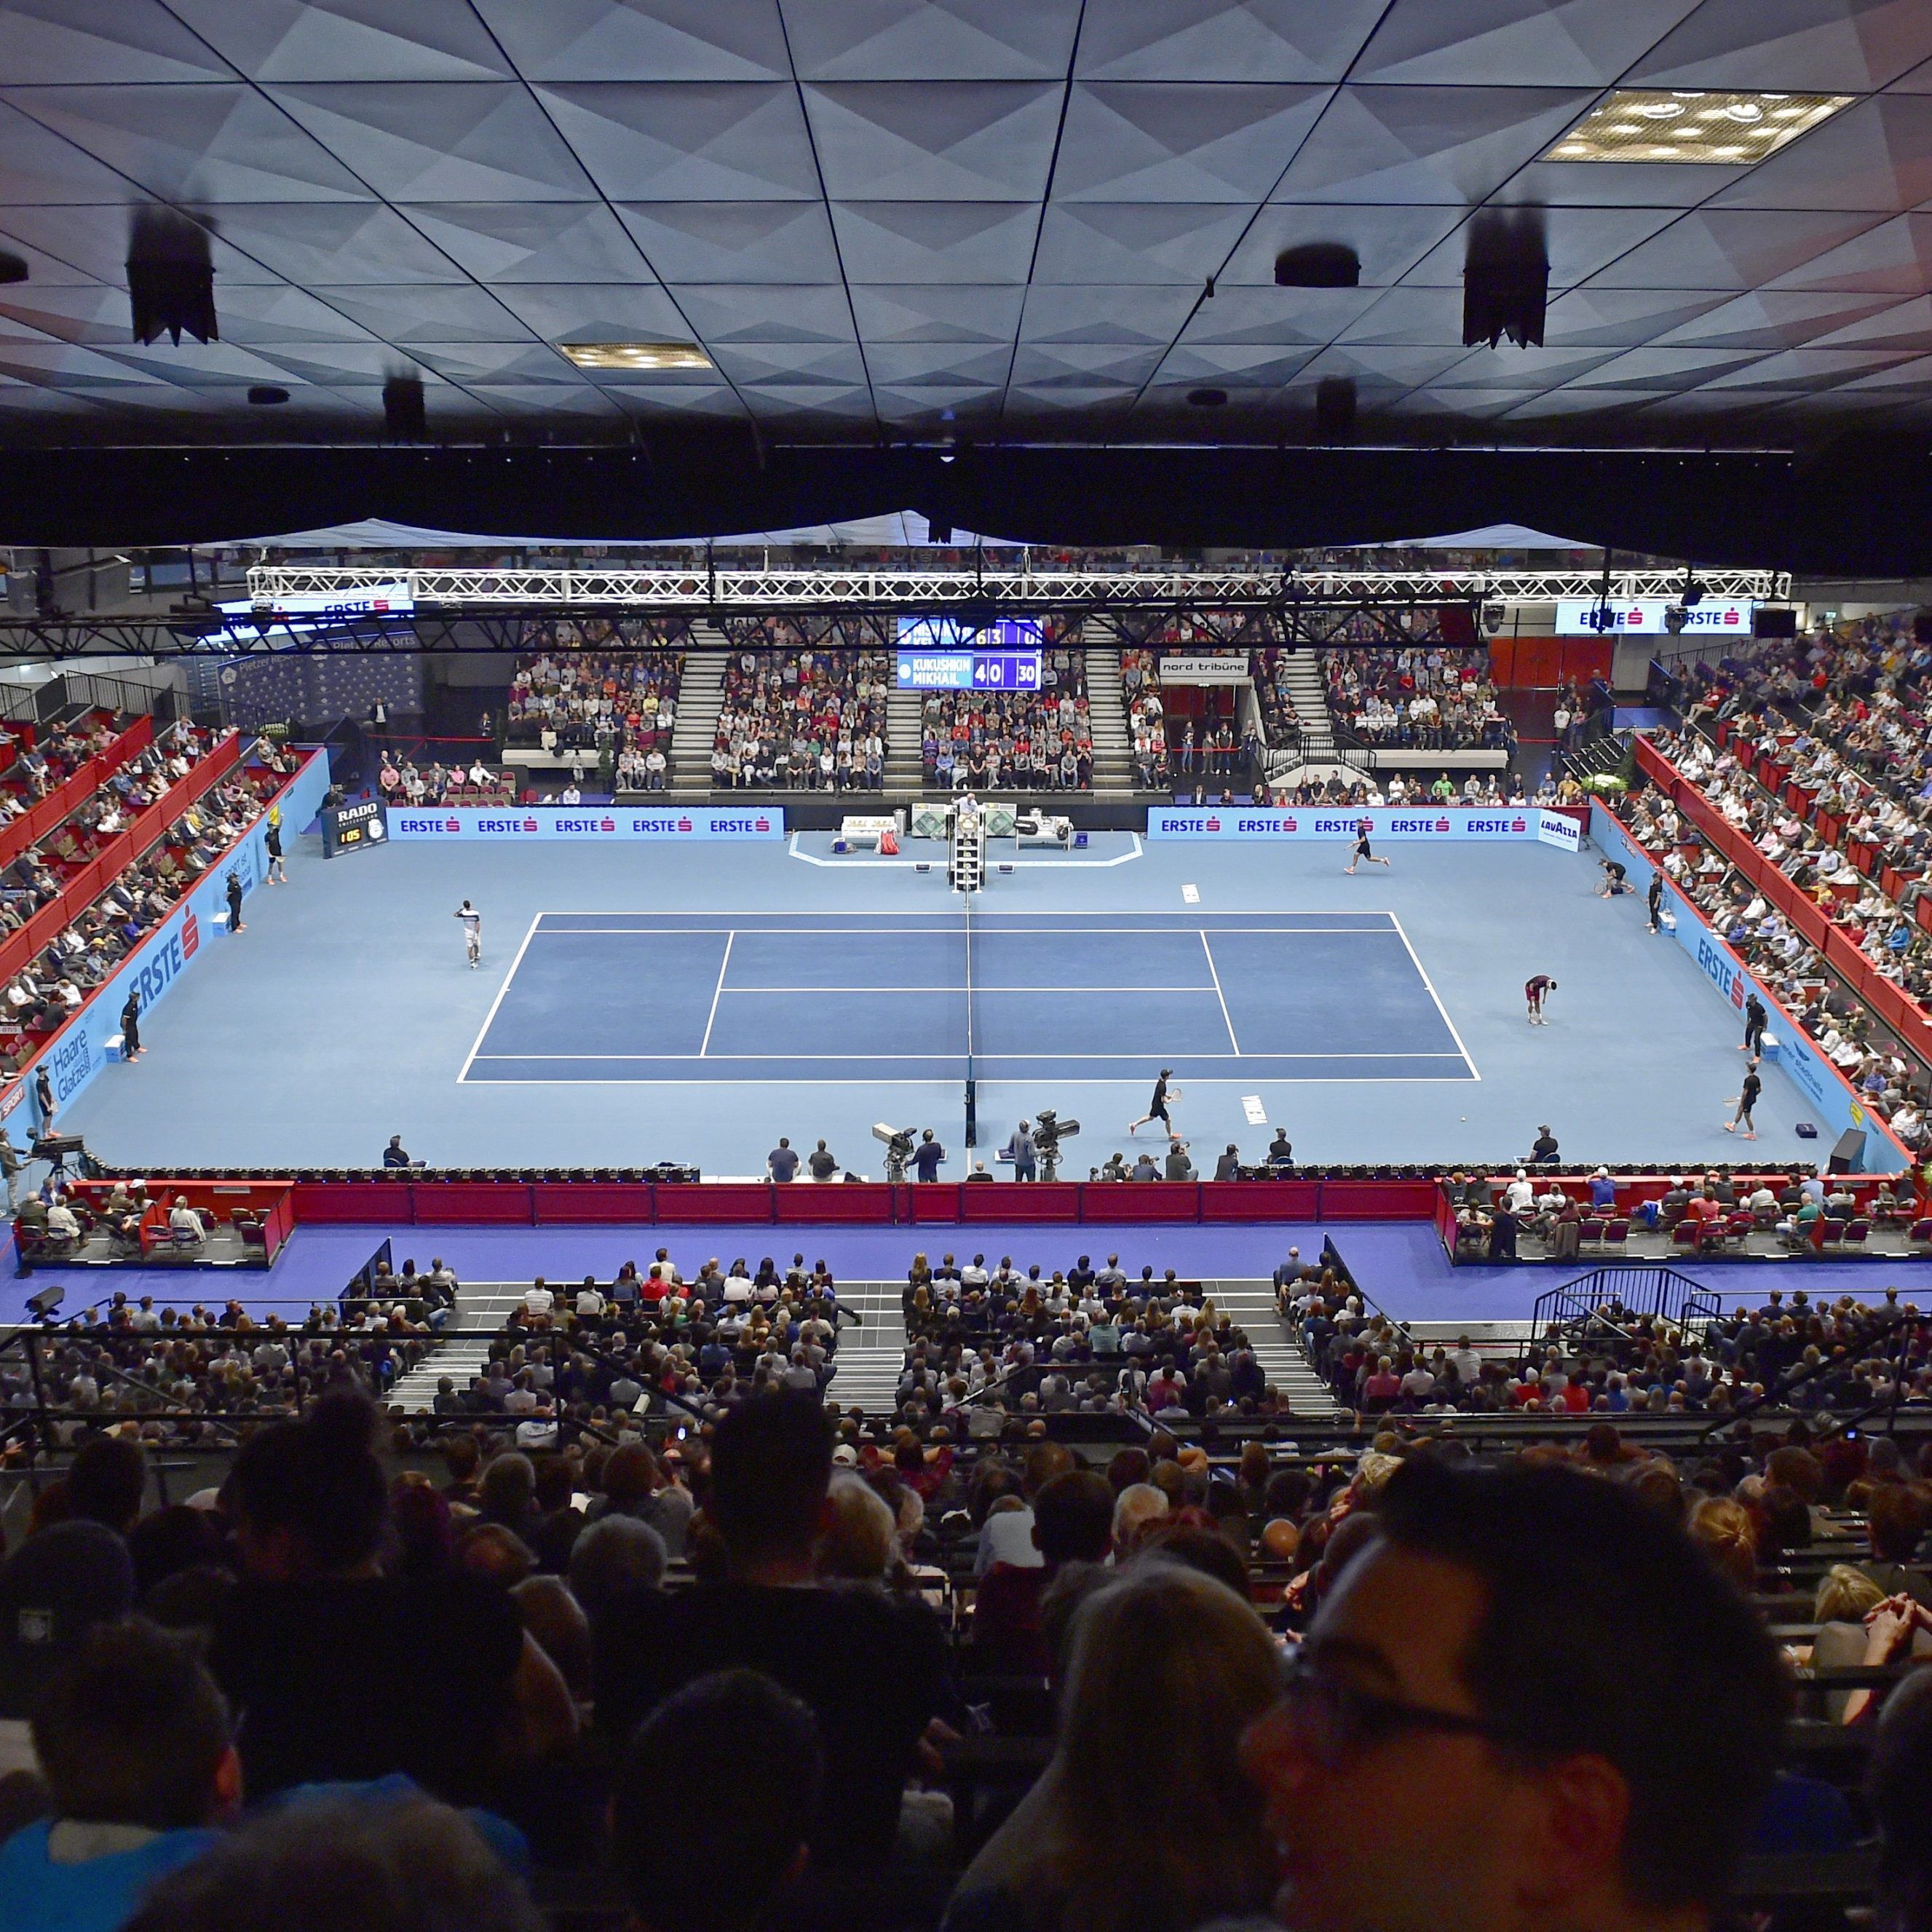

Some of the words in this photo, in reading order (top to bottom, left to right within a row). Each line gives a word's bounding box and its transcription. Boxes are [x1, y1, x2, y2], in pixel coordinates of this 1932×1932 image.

[913, 659, 970, 671] KUKUSHKIN
[1163, 662, 1193, 670] nord
[1198, 662, 1245, 670] tribüne
[913, 672, 959, 685] MIKHAIL
[975, 664, 986, 682] 4
[990, 665, 1001, 682] 0
[1019, 665, 1034, 682] 30
[337, 802, 377, 823] RADO
[401, 820, 443, 831] ERSTE
[478, 820, 520, 831] ERSTE
[555, 820, 598, 831] ERSTE
[633, 820, 676, 831] ERSTE
[710, 820, 753, 831] ERSTE
[1162, 820, 1203, 831] ERSTE
[1238, 820, 1280, 831] ERSTE
[1315, 820, 1357, 831] ERSTE
[1391, 820, 1433, 832] ERSTE
[1468, 820, 1509, 832] ERSTE
[1540, 820, 1577, 839] LAVAZZA
[1698, 937, 1732, 996] ERSTE
[53, 1029, 87, 1077] Haare
[58, 1064, 86, 1101] Glatze
